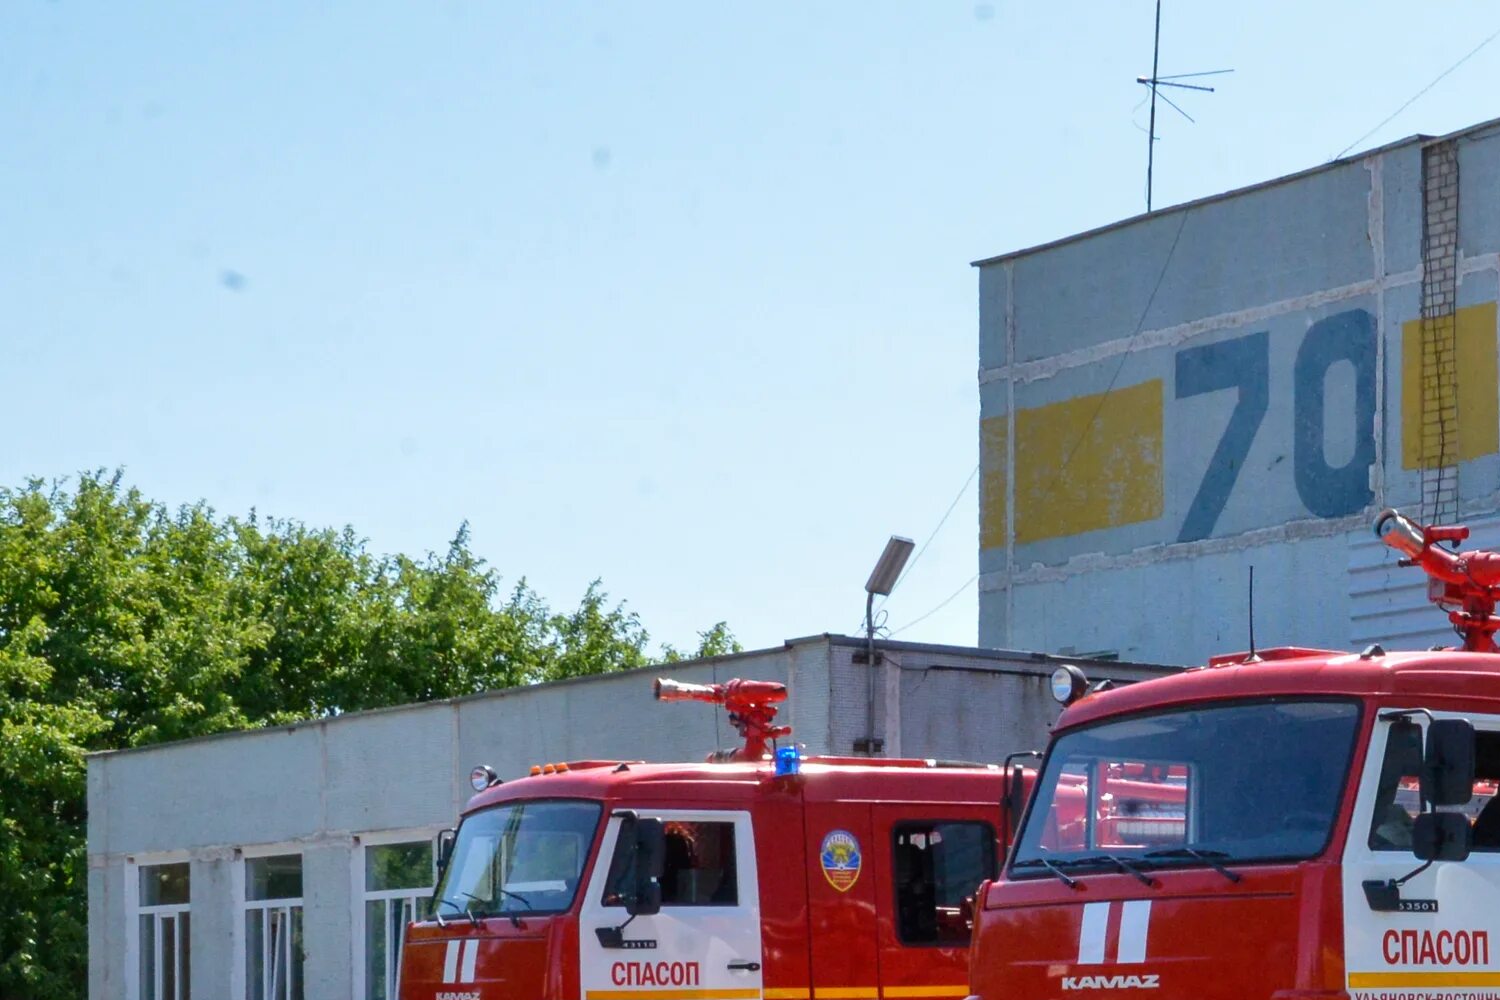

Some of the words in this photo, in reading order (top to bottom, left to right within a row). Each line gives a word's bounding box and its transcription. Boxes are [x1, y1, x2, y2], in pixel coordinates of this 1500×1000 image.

[1175, 308, 1378, 542] 70
[1382, 929, 1489, 965] СПАСОП
[611, 961, 700, 986] СПАСОП
[1061, 974, 1160, 990] KAMAZ
